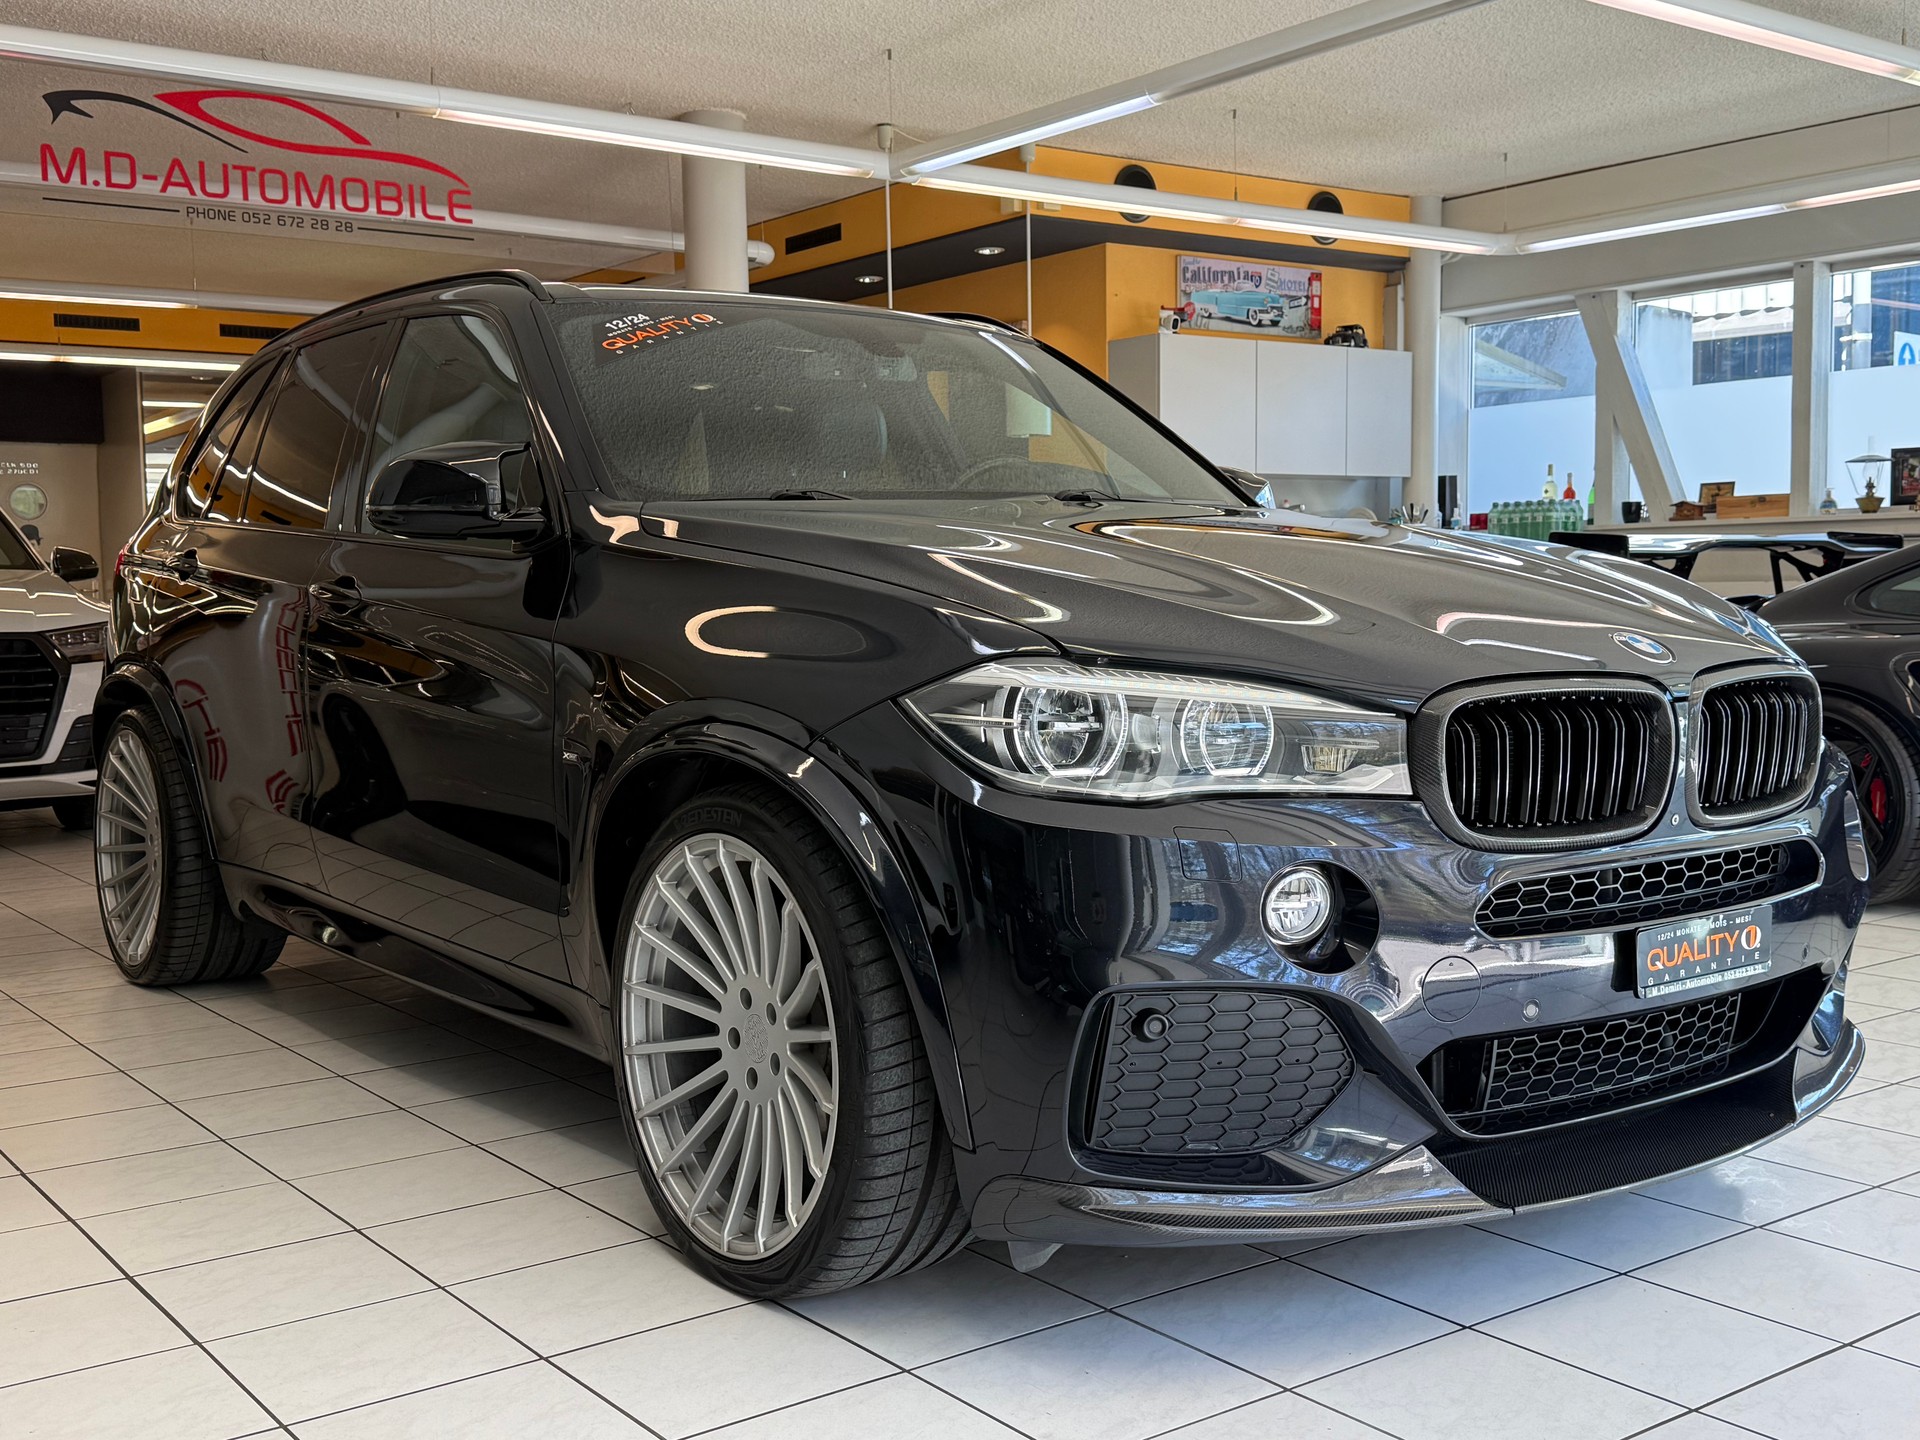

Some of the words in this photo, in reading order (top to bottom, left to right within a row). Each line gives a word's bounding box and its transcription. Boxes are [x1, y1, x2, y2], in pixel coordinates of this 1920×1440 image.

[40, 143, 473, 224] M.D-AUTOMOBILE
[186, 206, 237, 222] PHONE
[241, 211, 271, 225] 052
[277, 215, 305, 228] 672
[310, 218, 330, 231] 28
[335, 220, 354, 233] 28
[1182, 264, 1251, 284] California
[601, 317, 693, 350] QUALITY
[605, 313, 650, 330] 12/24
[1657, 931, 1674, 942] 12/24
[1676, 926, 1702, 937] MONATE
[1709, 918, 1728, 930] MOIS
[1735, 914, 1752, 924] MESI
[1647, 929, 1740, 972] QUALITY
[1648, 951, 1760, 986] GARANTIE
